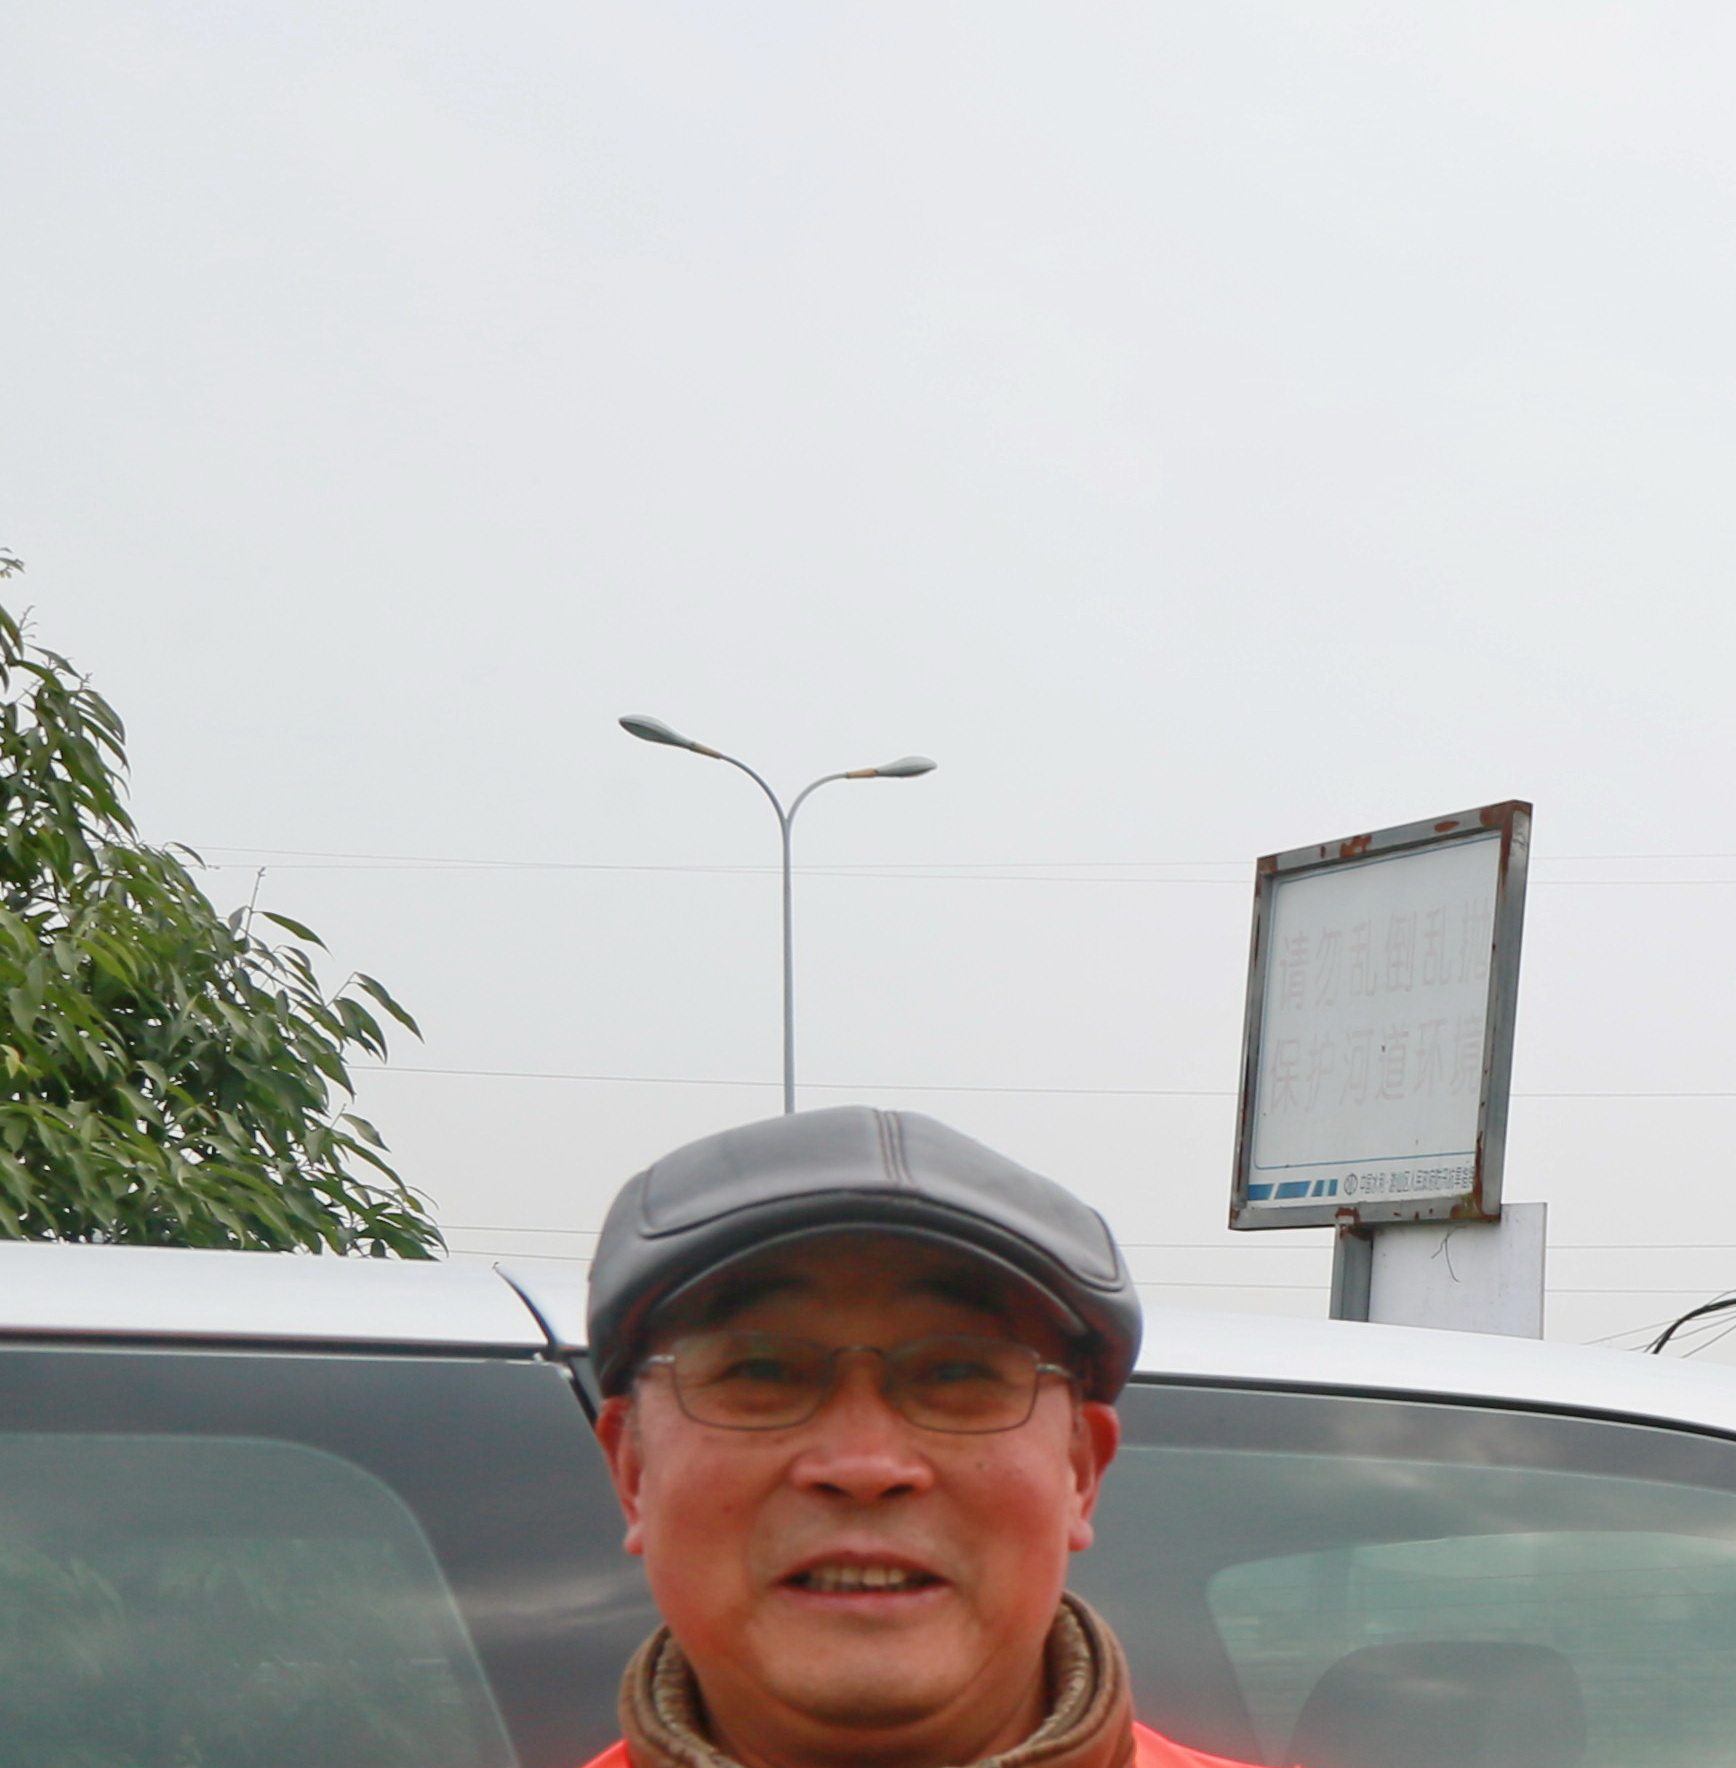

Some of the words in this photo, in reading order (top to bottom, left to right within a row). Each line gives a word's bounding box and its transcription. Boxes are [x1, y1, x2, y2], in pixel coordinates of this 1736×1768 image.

[1269, 1012, 1483, 1114] 保护河道环境
